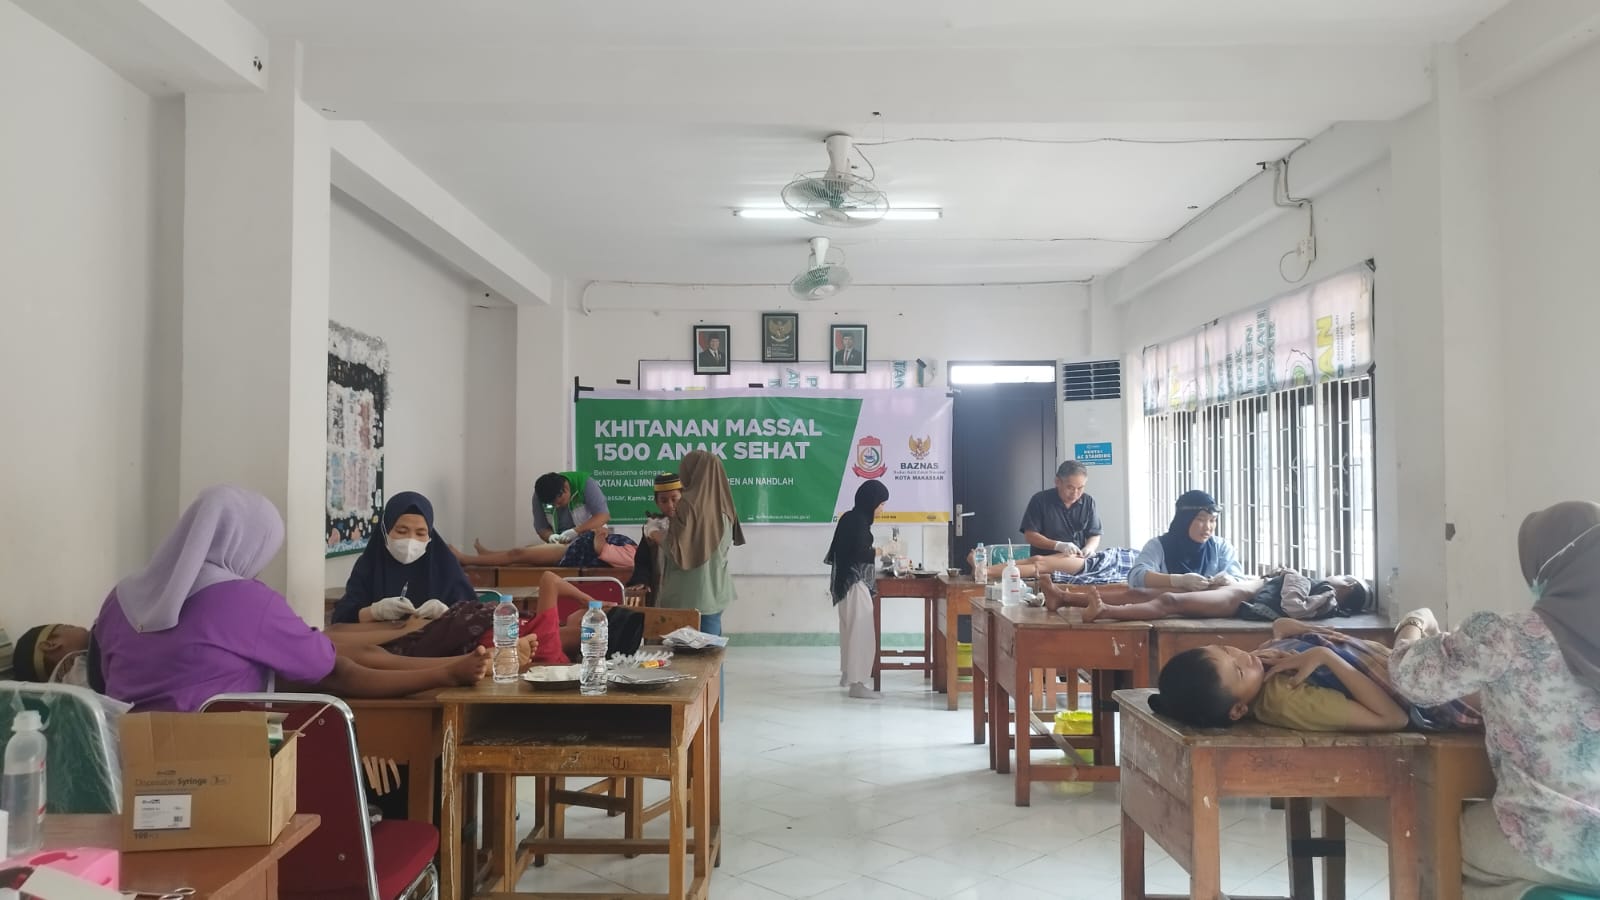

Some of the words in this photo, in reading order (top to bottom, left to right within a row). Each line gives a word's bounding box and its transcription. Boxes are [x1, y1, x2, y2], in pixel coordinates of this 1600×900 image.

[595, 419, 719, 438] KHITANAN
[726, 418, 823, 437] MASSAL
[594, 442, 651, 461] 1500
[657, 442, 728, 461] ANAK
[733, 441, 810, 460] SEHAT
[900, 462, 939, 470] BAZNAS
[593, 469, 638, 477] Bekerjasama
[598, 479, 622, 488] KATAN
[623, 479, 655, 488] ALUMNI
[742, 478, 754, 486] AN
[755, 477, 794, 486] NAHDLAH
[177, 776, 208, 786] Syringe
